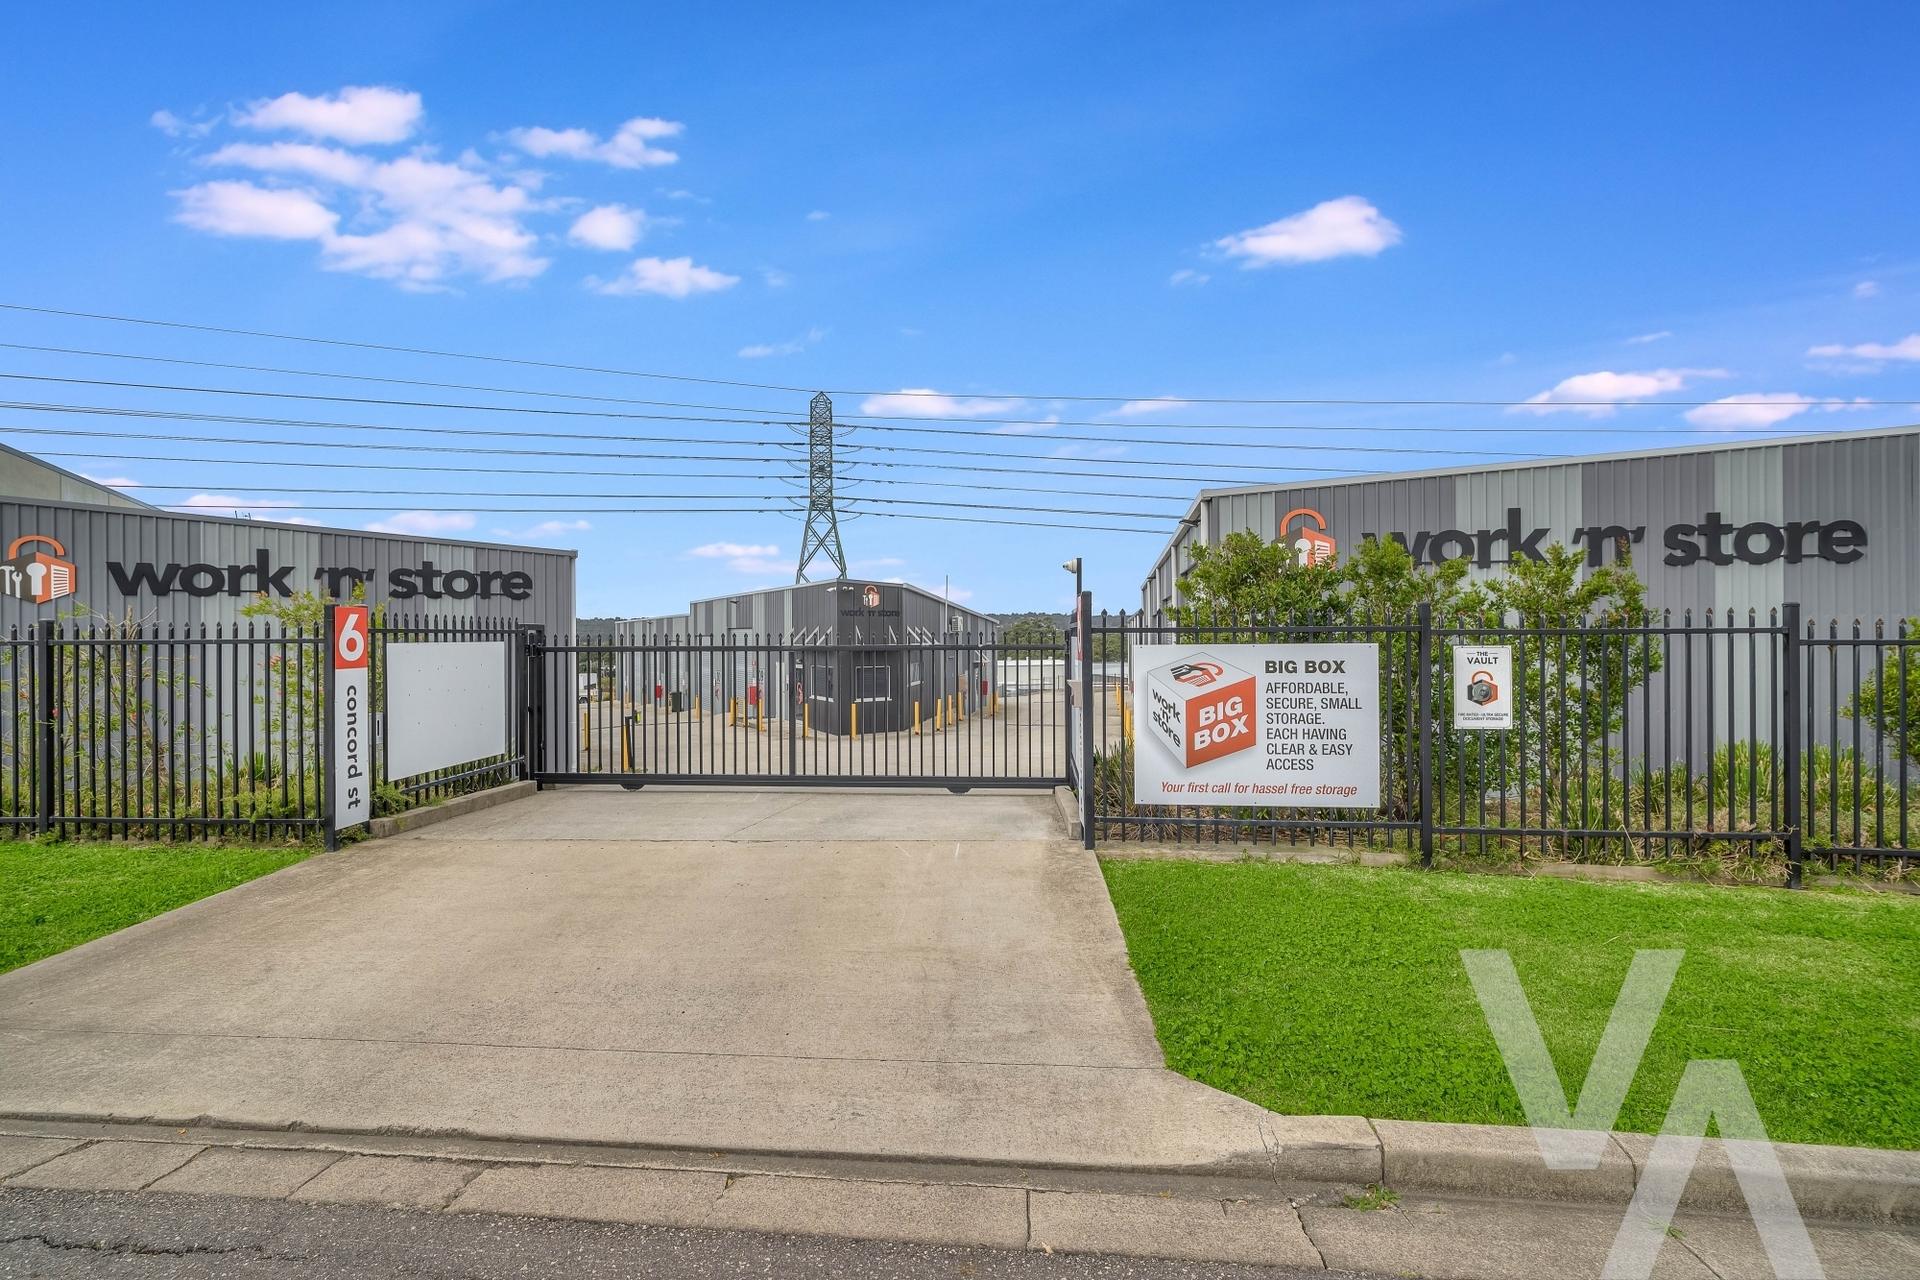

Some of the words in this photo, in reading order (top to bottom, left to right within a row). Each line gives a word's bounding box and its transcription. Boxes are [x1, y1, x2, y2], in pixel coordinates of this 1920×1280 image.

[1663, 512, 1867, 566] store
[106, 549, 296, 597] work
[388, 561, 533, 600] store
[338, 613, 365, 662] 6
[1265, 660, 1297, 674] BIG
[1304, 660, 1346, 674] BOX
[1467, 657, 1498, 665] VAULT
[1265, 682, 1348, 696] AFFORDABLE,
[1152, 689, 1181, 724] work
[1200, 696, 1243, 727] BIG
[1266, 697, 1317, 711] SECURE,
[1320, 698, 1362, 710] SMALL
[1266, 713, 1325, 725] STORAGE.
[347, 685, 362, 779] concord
[1152, 711, 1181, 748] store
[1194, 714, 1249, 751] BOX
[1266, 728, 1298, 740] EACH
[1302, 728, 1347, 740] HAVING
[1266, 743, 1305, 755] CLEAR
[1309, 744, 1318, 755] &
[1322, 743, 1353, 756] EASY
[1266, 758, 1314, 770] ACCESS
[347, 787, 361, 809] st
[1162, 782, 1185, 793] Your
[1188, 782, 1209, 793] first
[1211, 782, 1231, 793] call
[1234, 782, 1250, 794] for
[1252, 783, 1288, 795] hassel
[1290, 783, 1313, 795] free
[1315, 785, 1358, 798] storage
